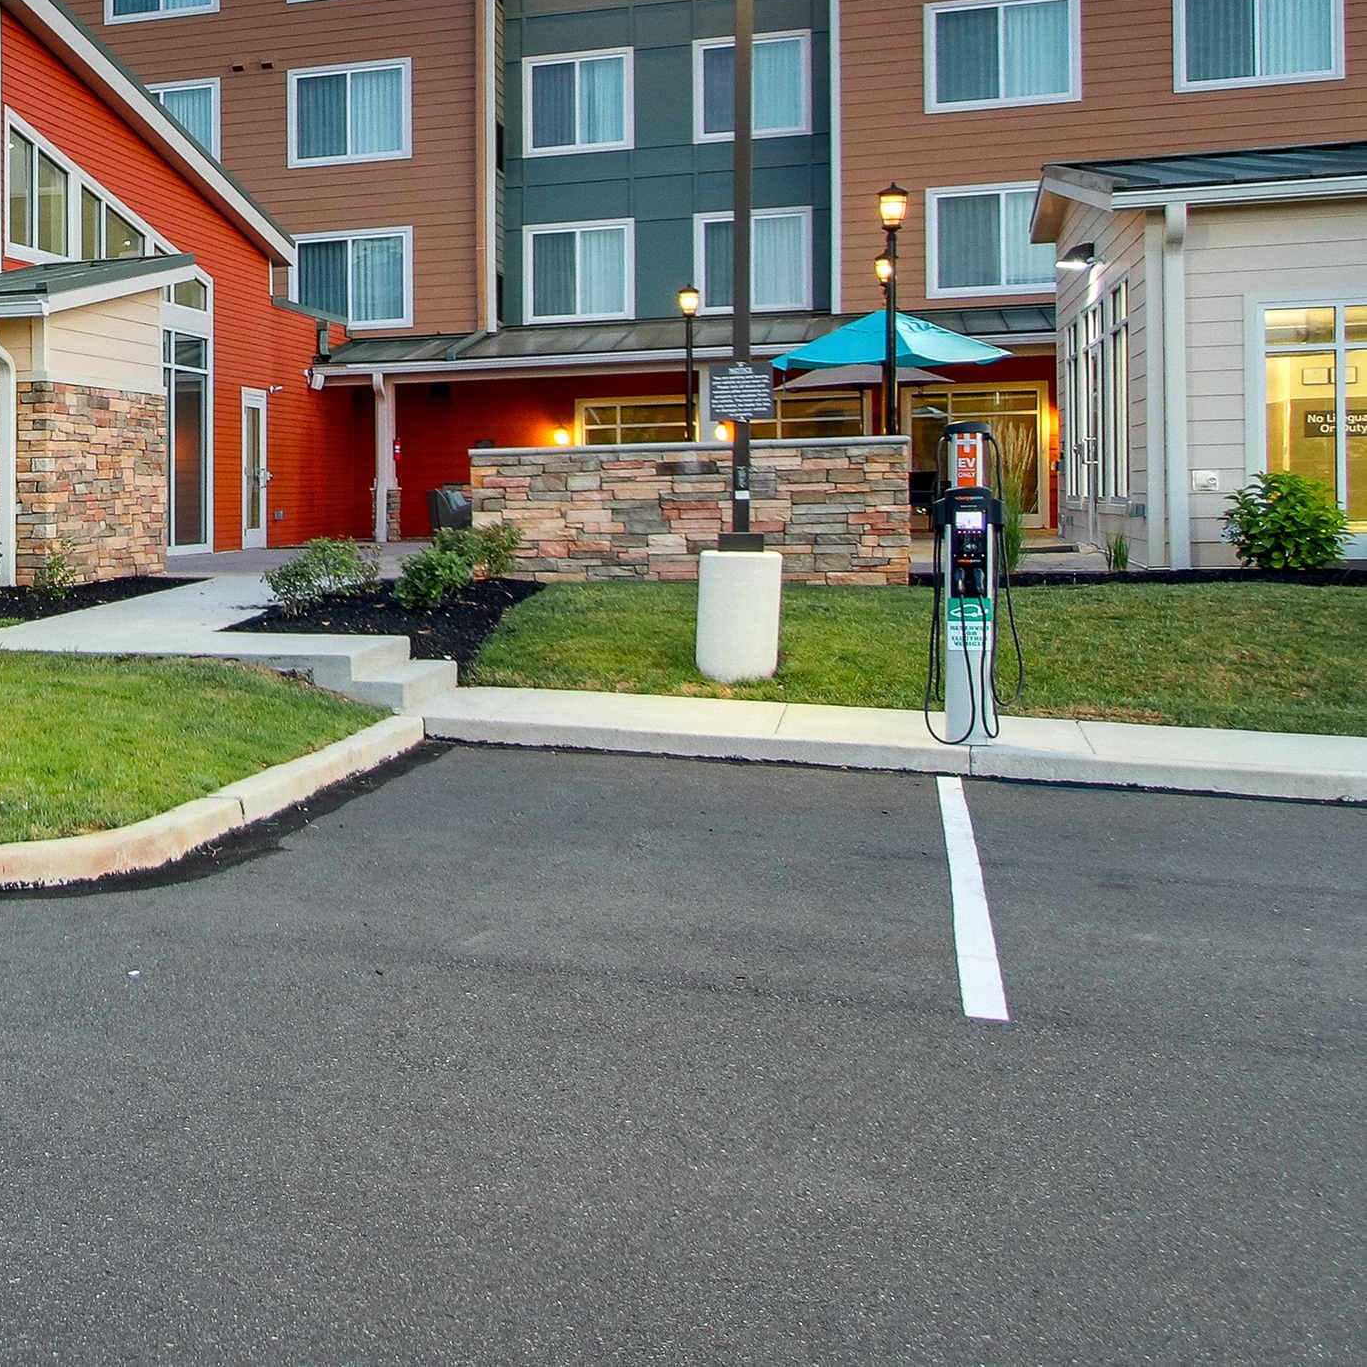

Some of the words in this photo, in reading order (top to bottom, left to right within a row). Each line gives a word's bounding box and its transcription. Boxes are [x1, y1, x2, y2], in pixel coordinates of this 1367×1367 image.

[1307, 414, 1324, 423] No
[1326, 413, 1367, 424] Ligua
[958, 457, 976, 468] EV
